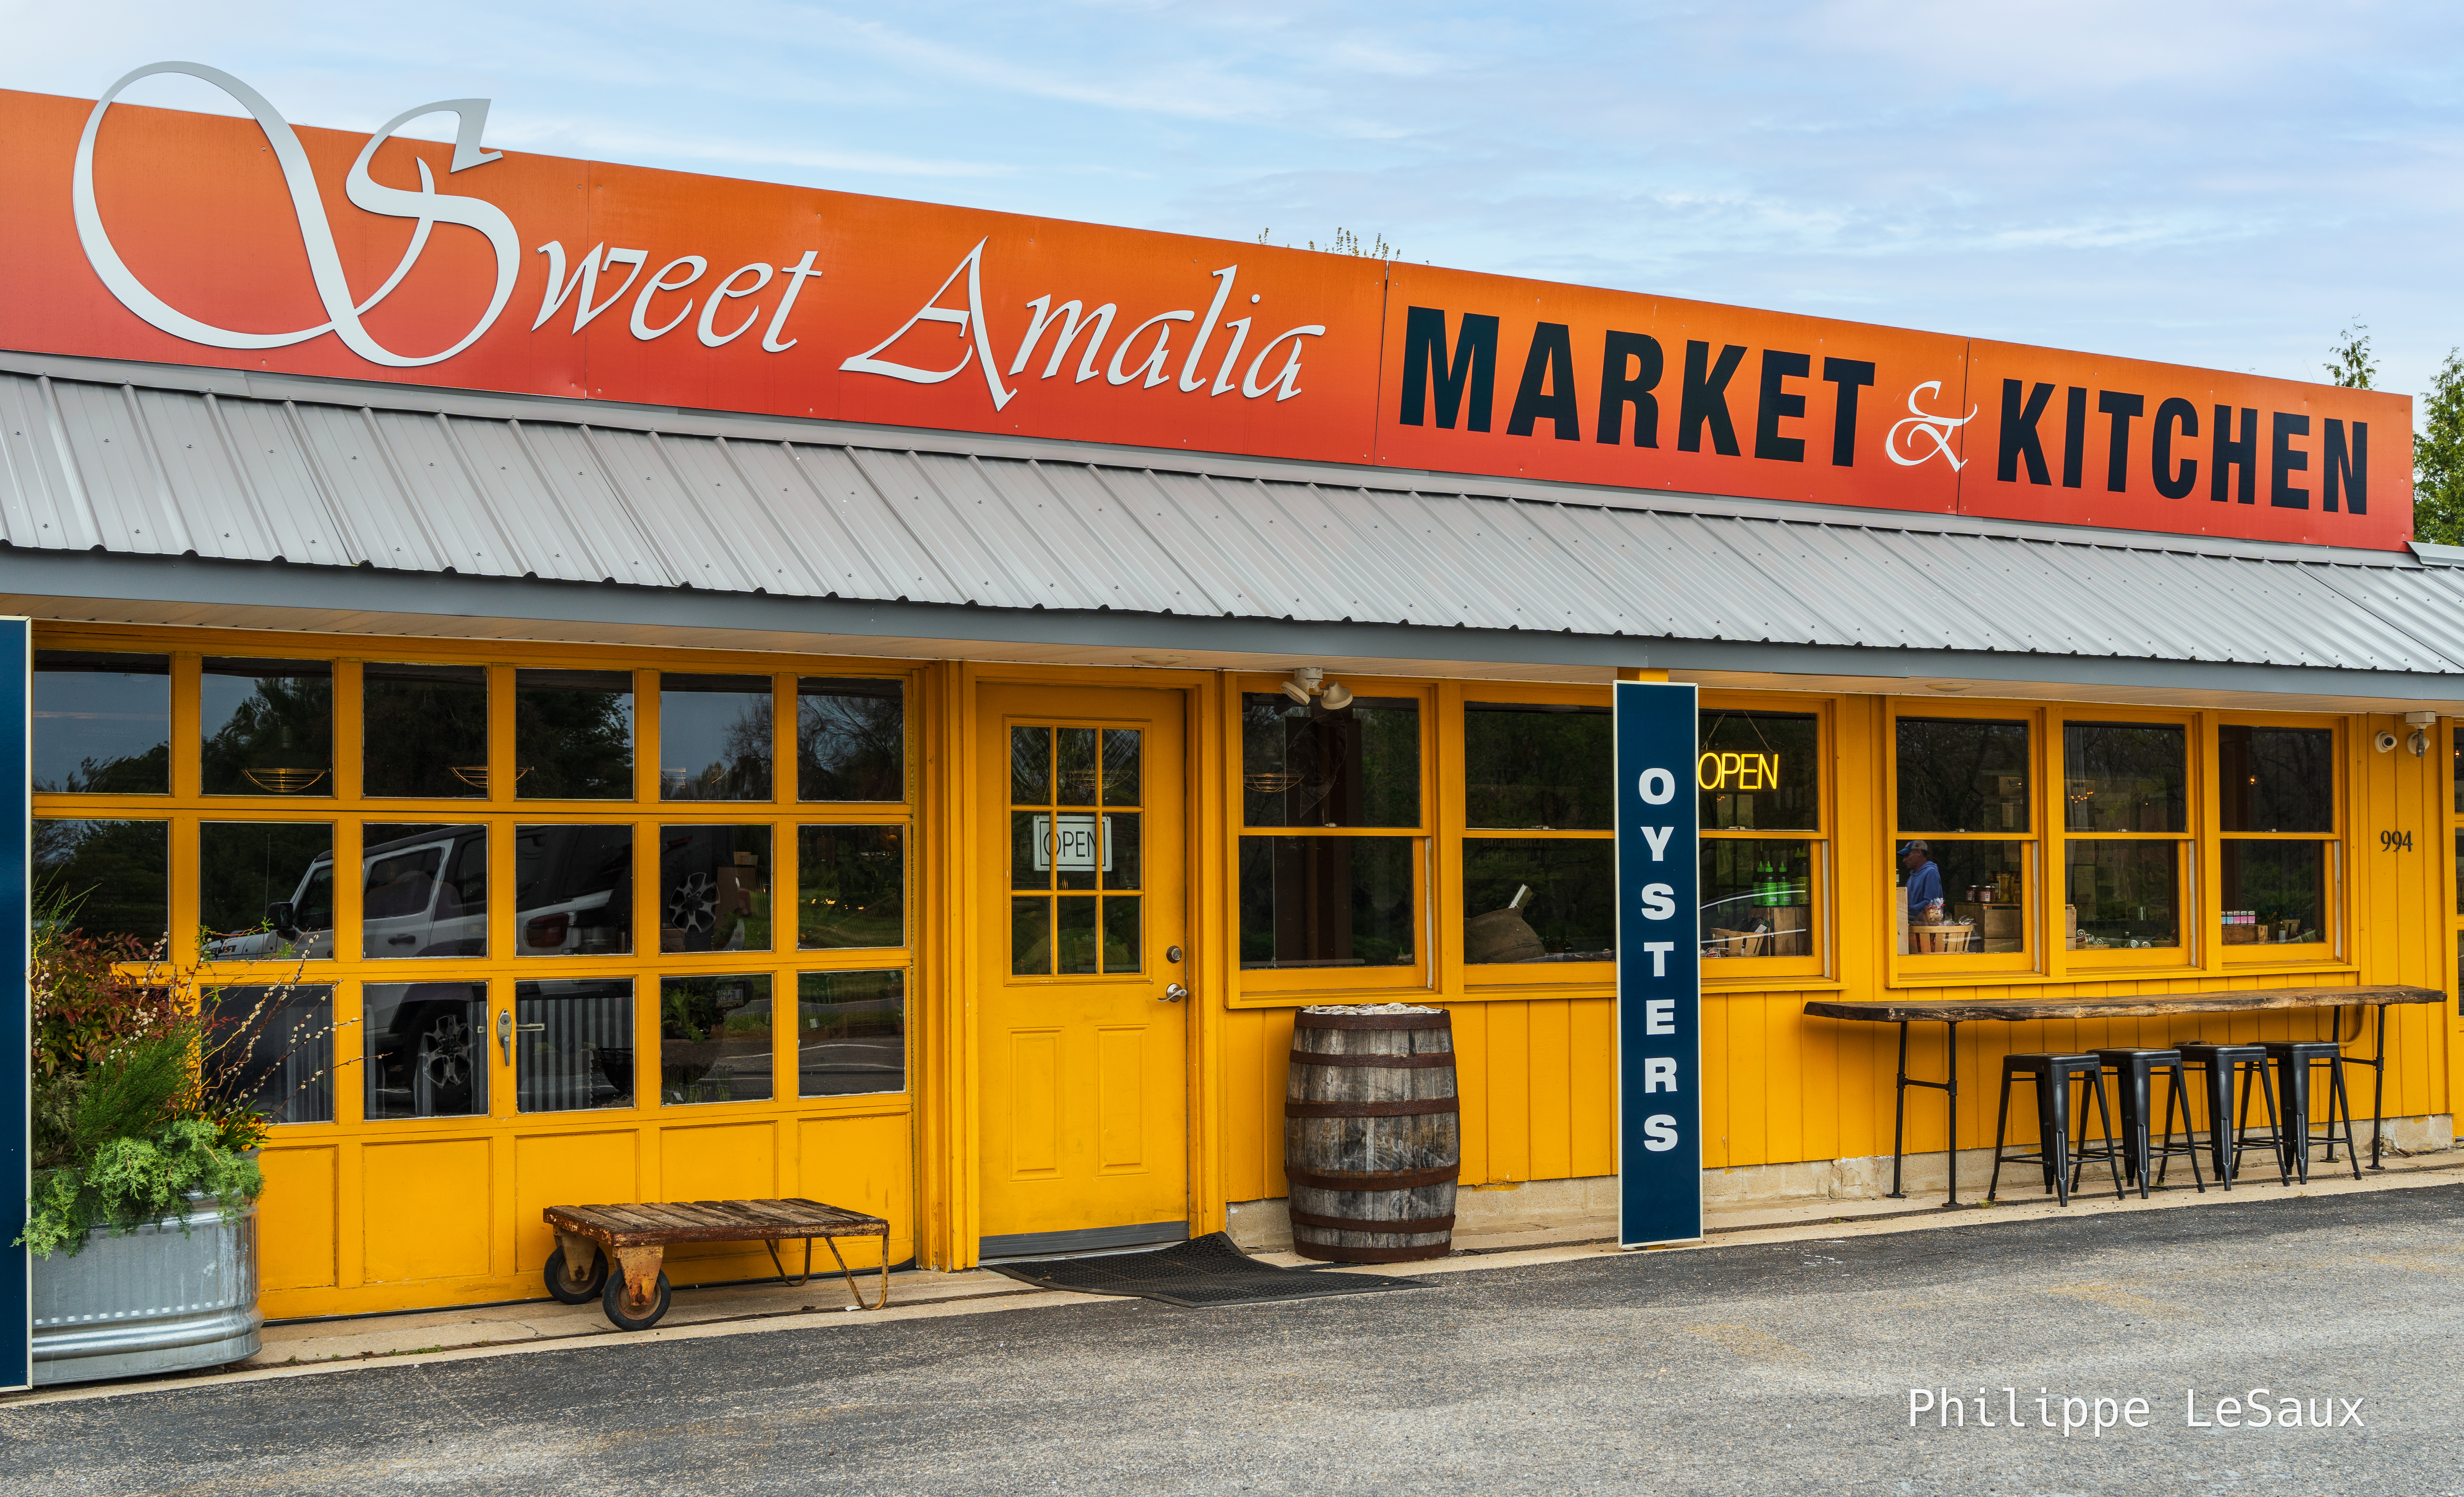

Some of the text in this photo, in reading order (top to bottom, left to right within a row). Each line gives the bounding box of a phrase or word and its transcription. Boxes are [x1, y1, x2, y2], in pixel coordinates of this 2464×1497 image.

[73, 61, 2368, 515] Sweet Amalia MARKET & KITCHEN
[1697, 753, 1778, 789] OPEN
[1043, 831, 1096, 857] OPEN
[2381, 830, 2413, 852] 994
[1638, 767, 1678, 1152] OYSTERS
